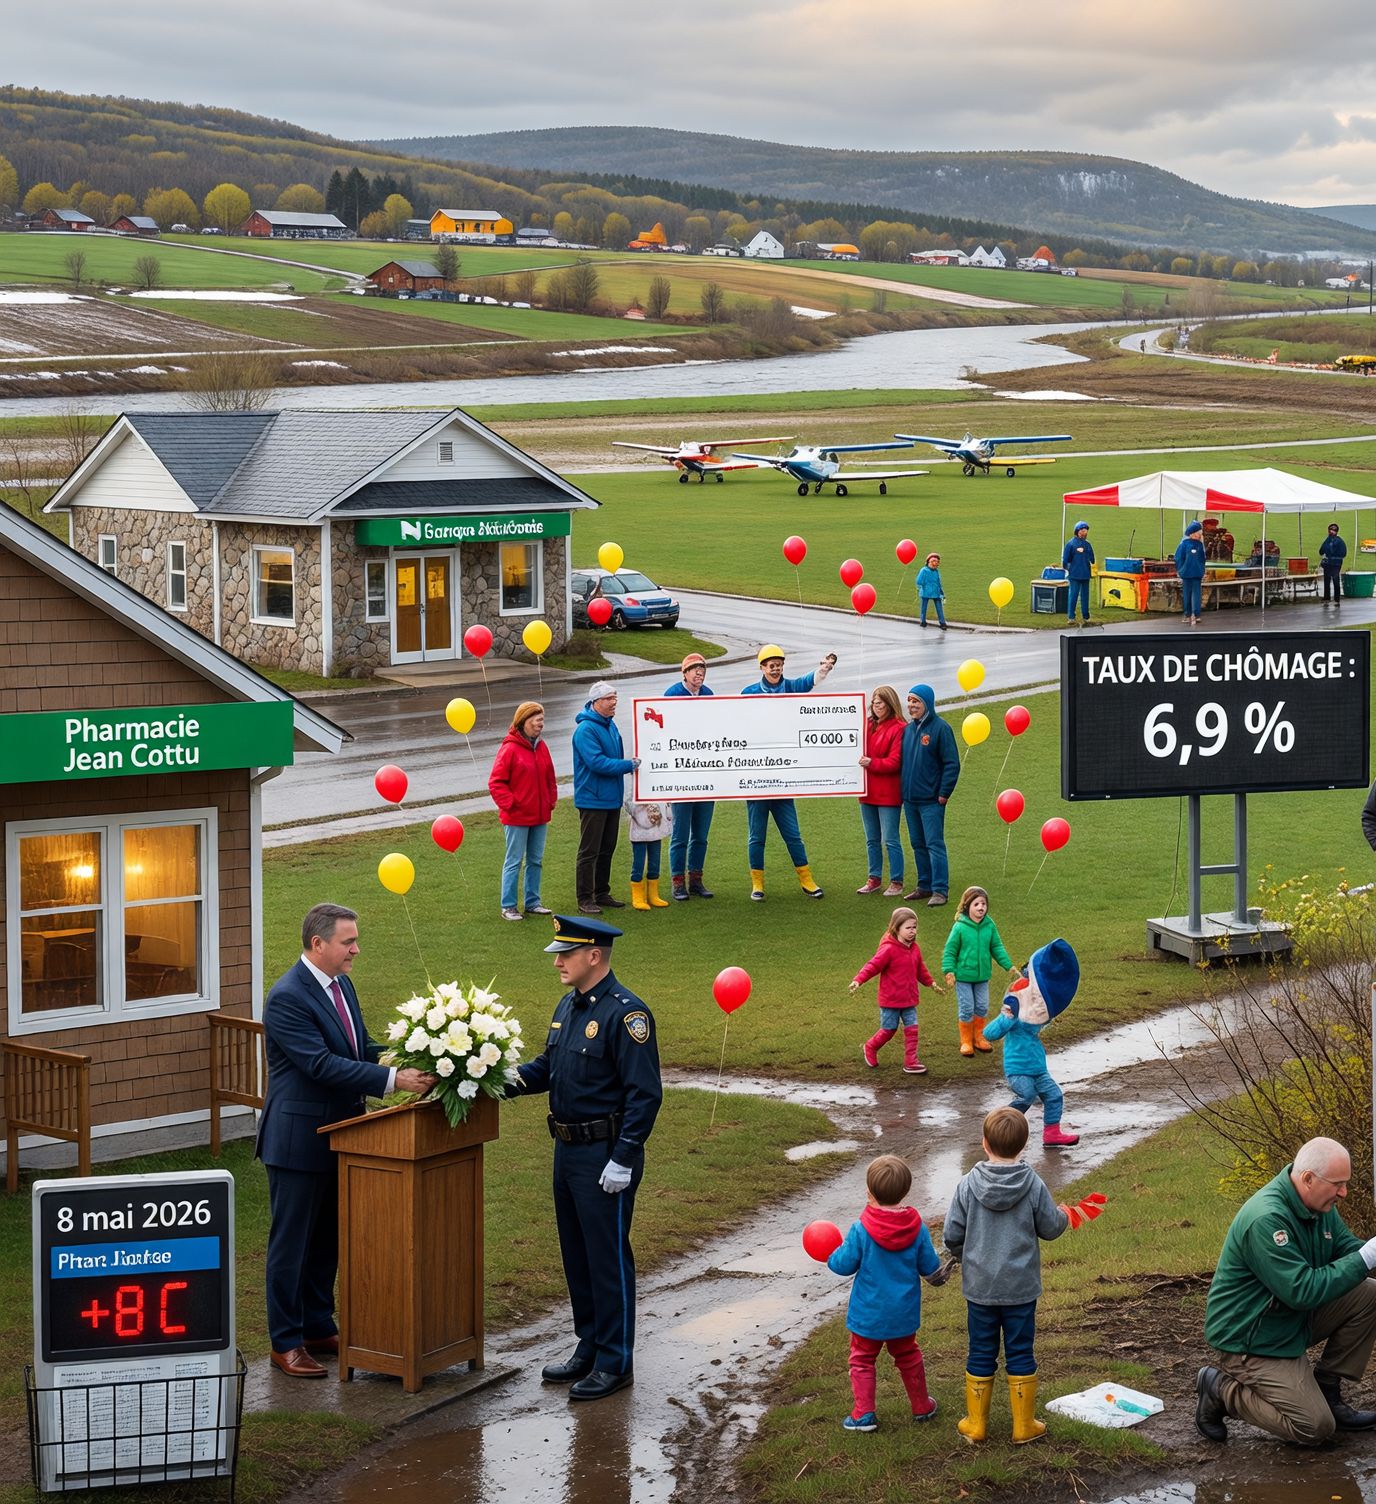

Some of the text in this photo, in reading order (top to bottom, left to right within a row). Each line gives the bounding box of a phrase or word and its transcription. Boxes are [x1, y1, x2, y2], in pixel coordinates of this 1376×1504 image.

[1082, 646, 1355, 684] TAUX DE CHÔMAGE :
[65, 713, 200, 745] Pharmacie
[820, 733, 843, 744] 000
[1143, 701, 1295, 766] 6,9 %
[63, 742, 200, 773] Jean Cottu
[57, 1199, 211, 1233] 8 mai 2026
[81, 1281, 188, 1337] +8 C
